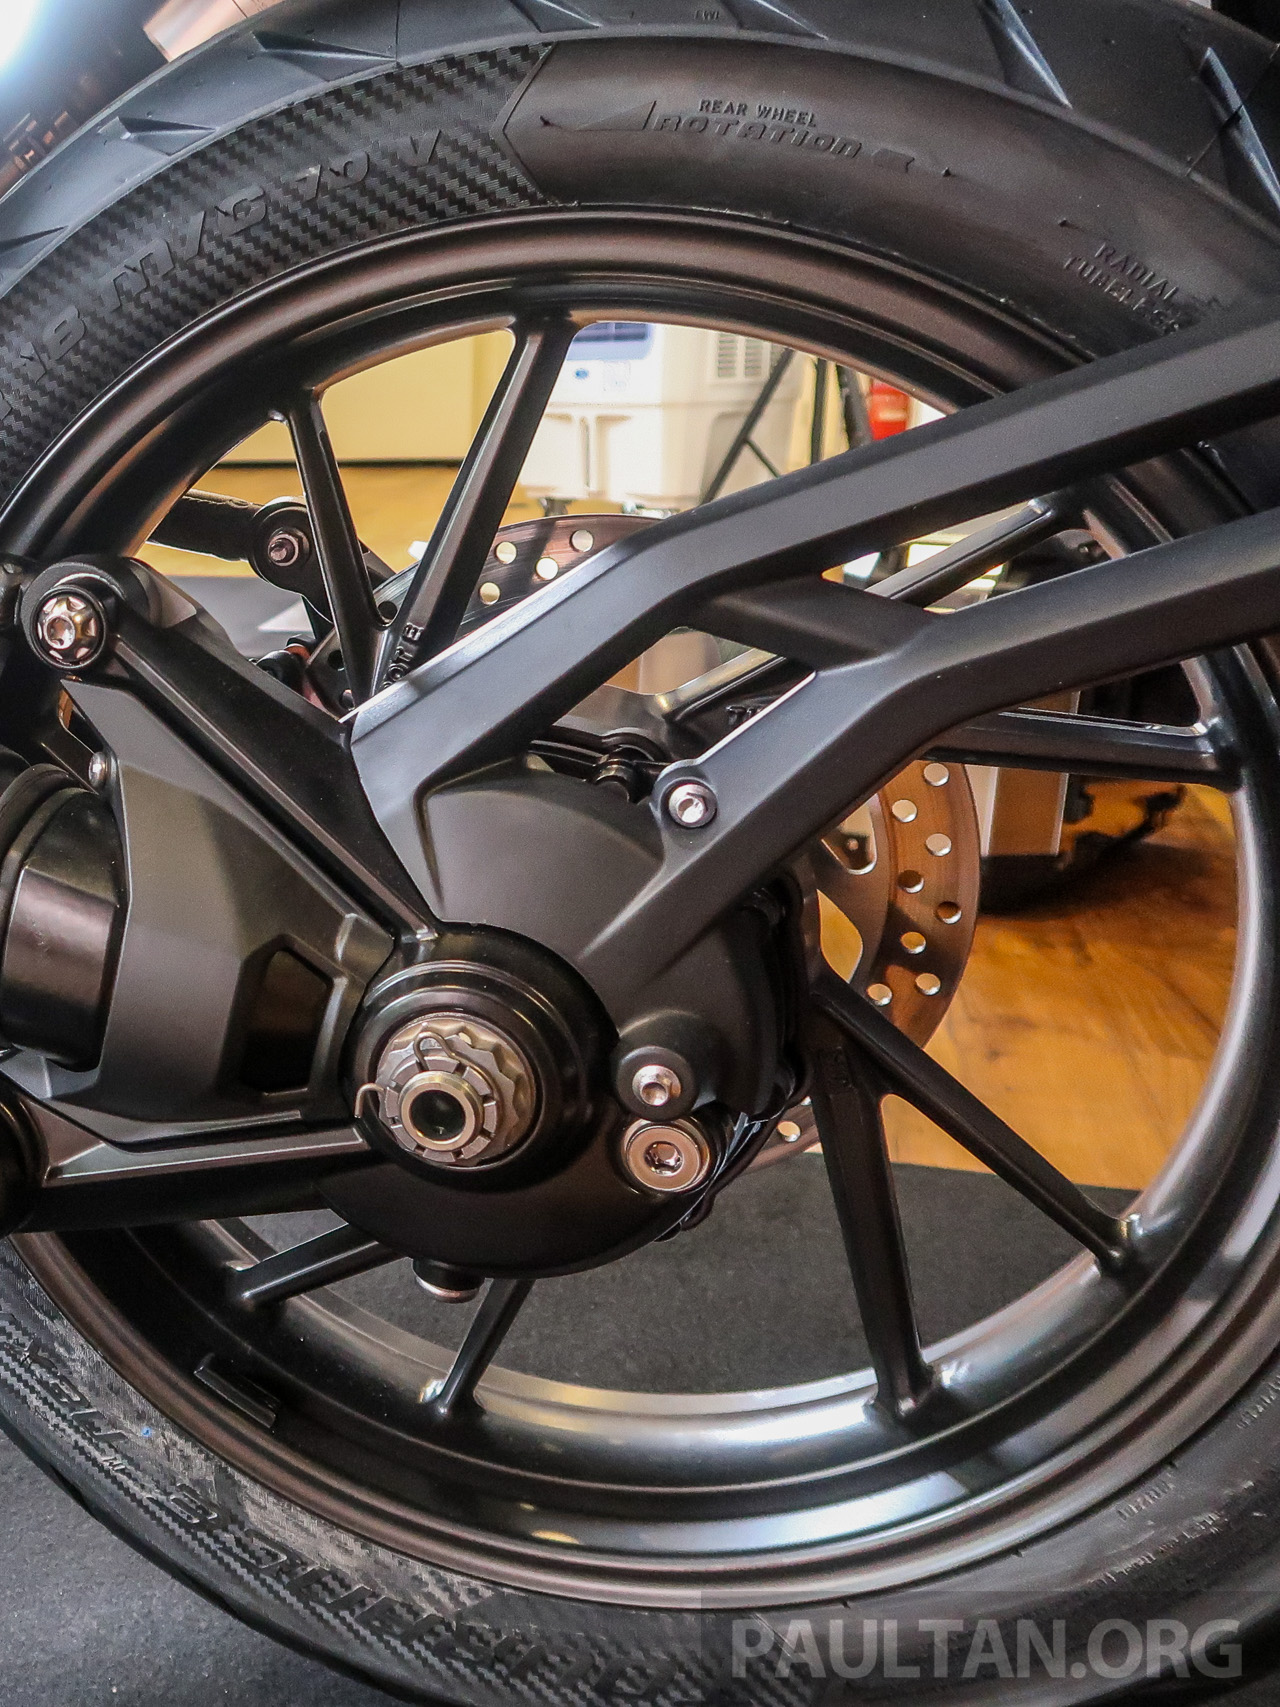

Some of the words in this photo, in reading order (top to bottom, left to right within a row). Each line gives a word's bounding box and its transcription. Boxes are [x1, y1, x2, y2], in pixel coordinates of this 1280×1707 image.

[698, 99, 748, 116] REAR
[756, 103, 817, 127] WHEEL
[653, 115, 863, 159] ROTATION
[1094, 241, 1180, 301] RADIAL
